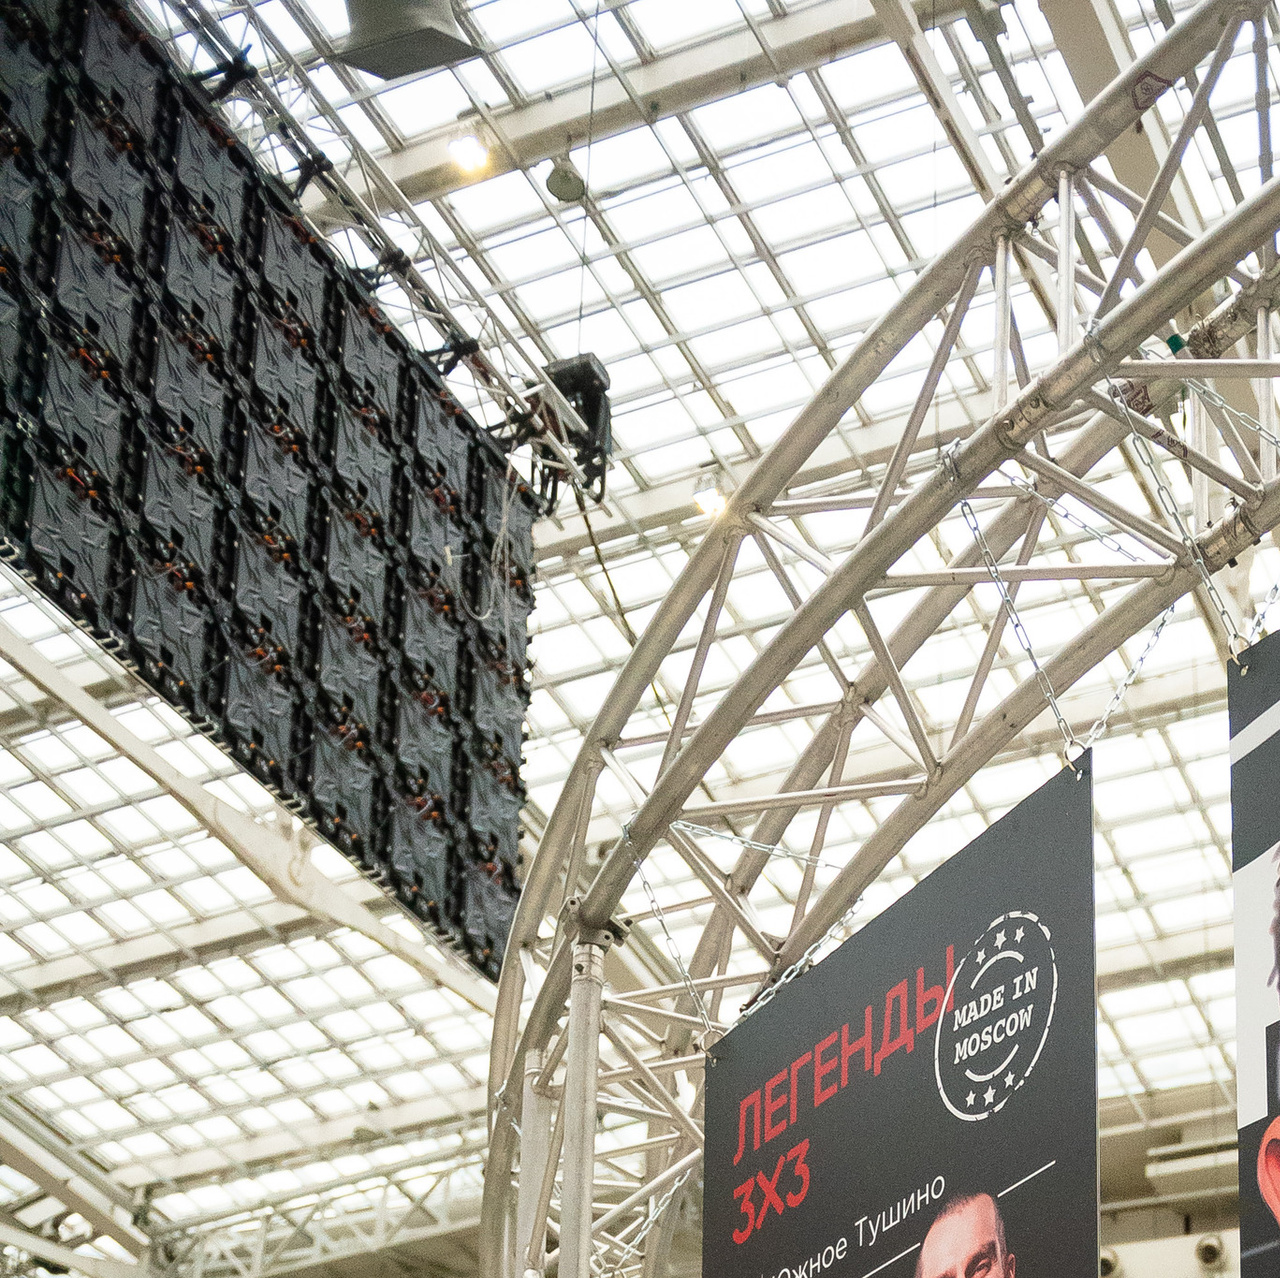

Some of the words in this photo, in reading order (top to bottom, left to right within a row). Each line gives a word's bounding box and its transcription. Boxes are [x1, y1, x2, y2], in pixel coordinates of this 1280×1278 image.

[953, 985, 1005, 1032] MADE
[1012, 966, 1039, 1000] IN
[953, 1003, 1034, 1065] MOSCOW
[733, 944, 955, 1166] ЛЕГЕНДЫ
[732, 1138, 811, 1245] 3X3
[854, 1175, 946, 1247] Тушино
